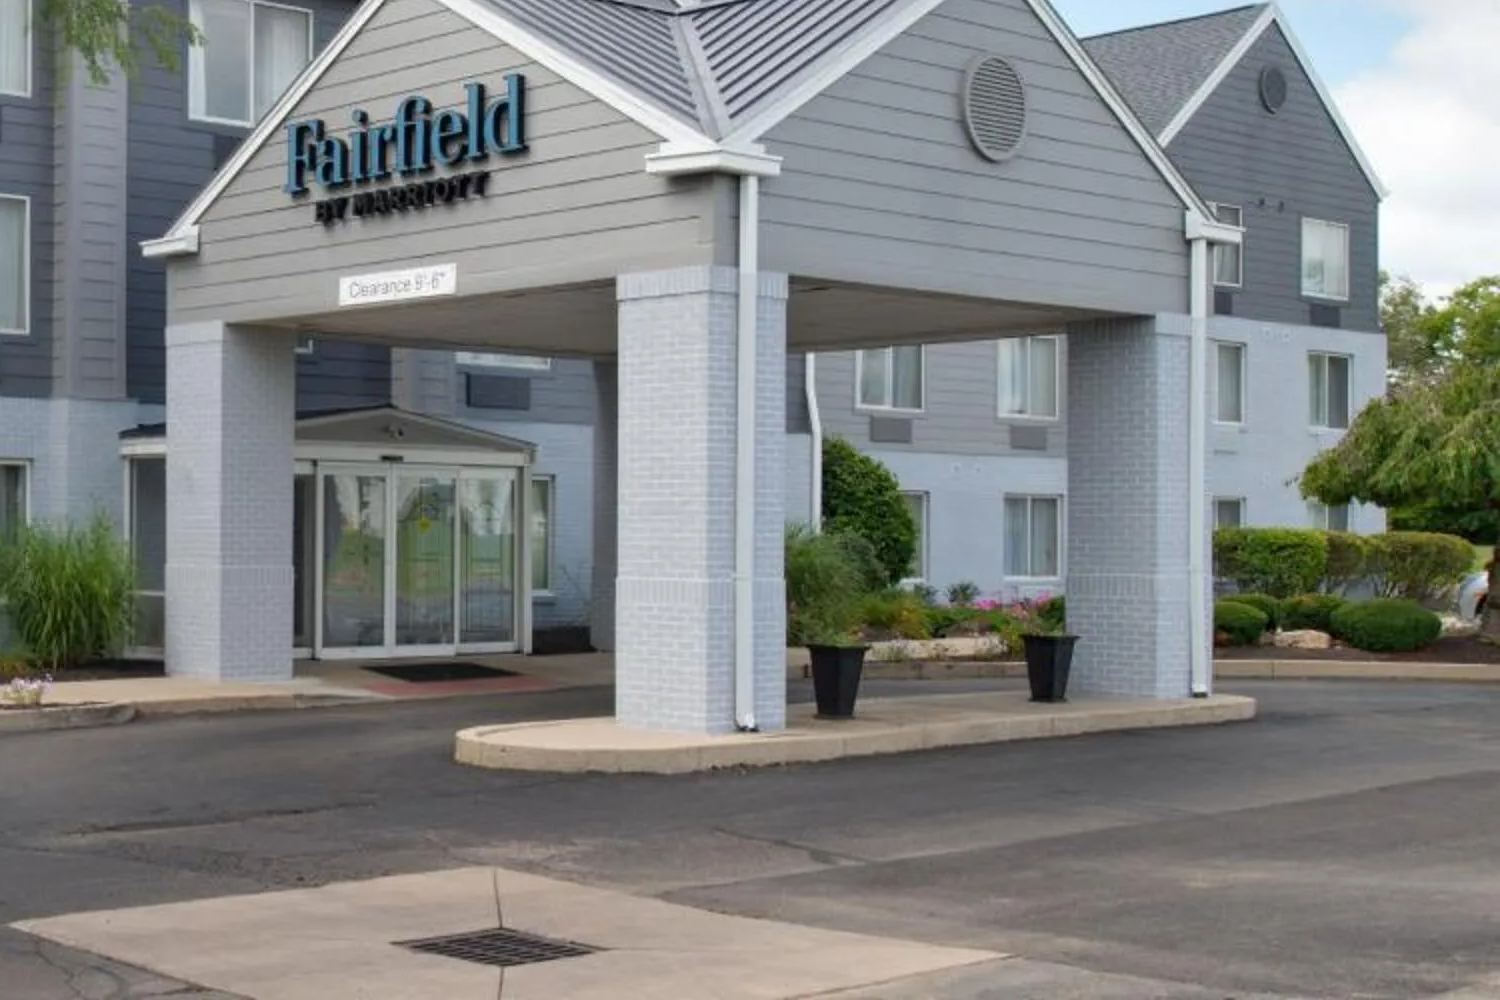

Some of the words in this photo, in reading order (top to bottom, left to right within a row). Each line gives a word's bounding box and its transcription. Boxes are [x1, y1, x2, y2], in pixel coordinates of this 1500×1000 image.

[284, 73, 529, 199] Fairfield
[315, 198, 349, 229] BY
[352, 171, 491, 218] MARRIOTT
[348, 278, 412, 298] Clearance
